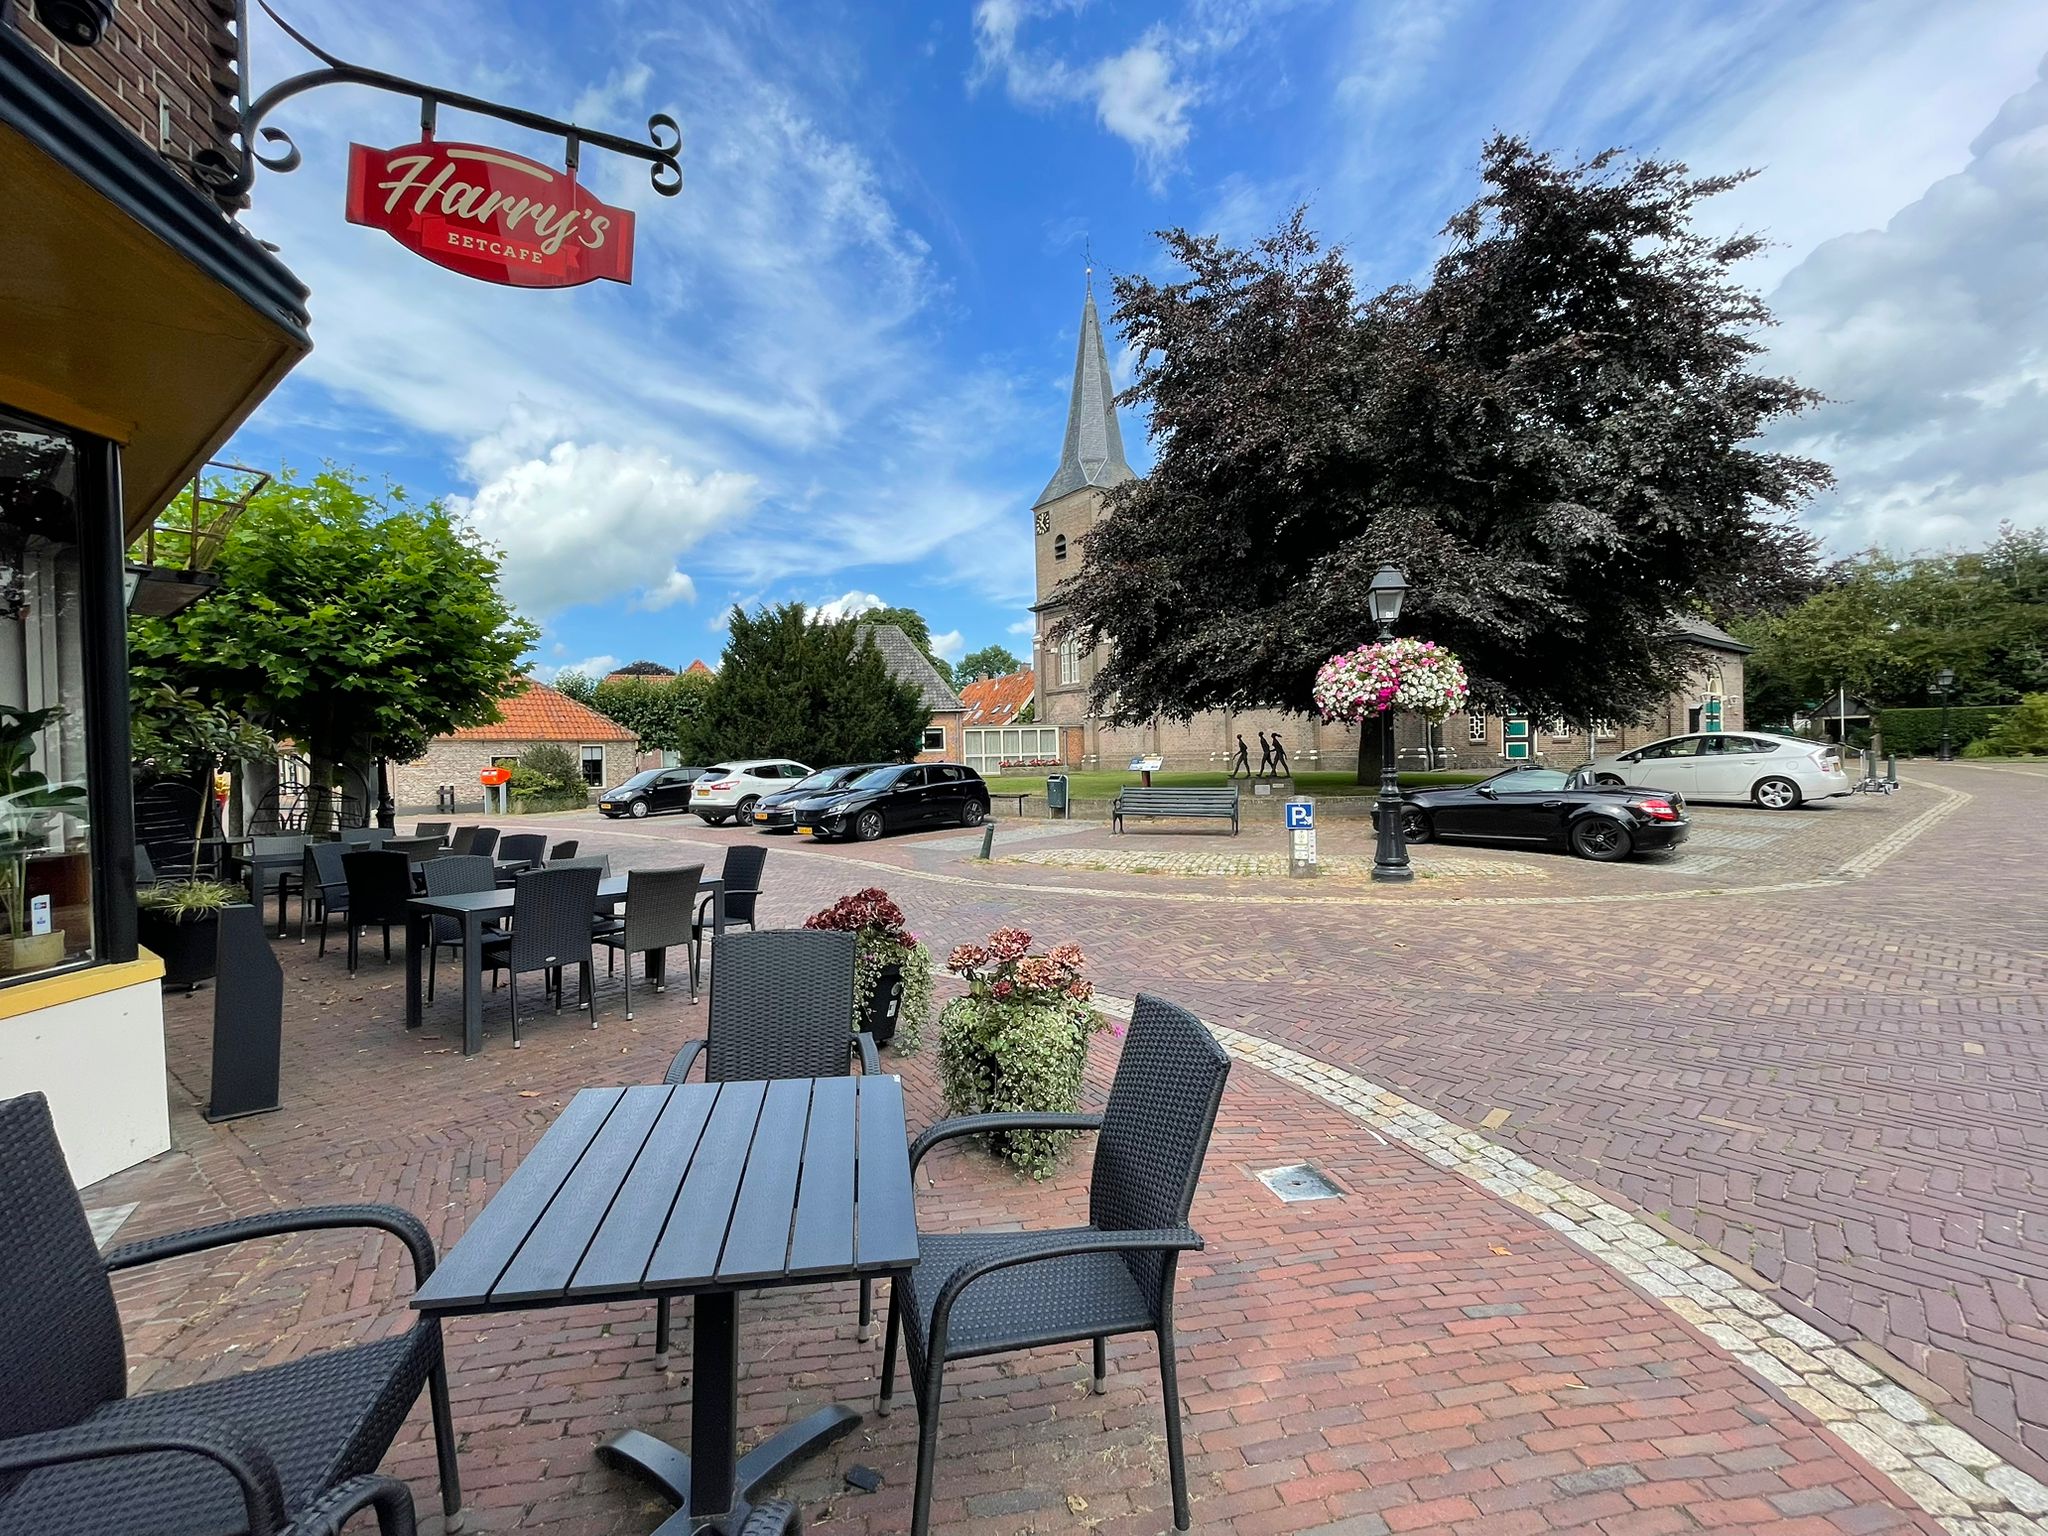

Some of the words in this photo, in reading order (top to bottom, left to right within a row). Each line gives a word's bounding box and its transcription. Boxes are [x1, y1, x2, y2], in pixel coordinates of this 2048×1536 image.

[378, 155, 610, 255] Harry's
[447, 232, 543, 265] EETCAFE
[1291, 806, 1307, 826] P
